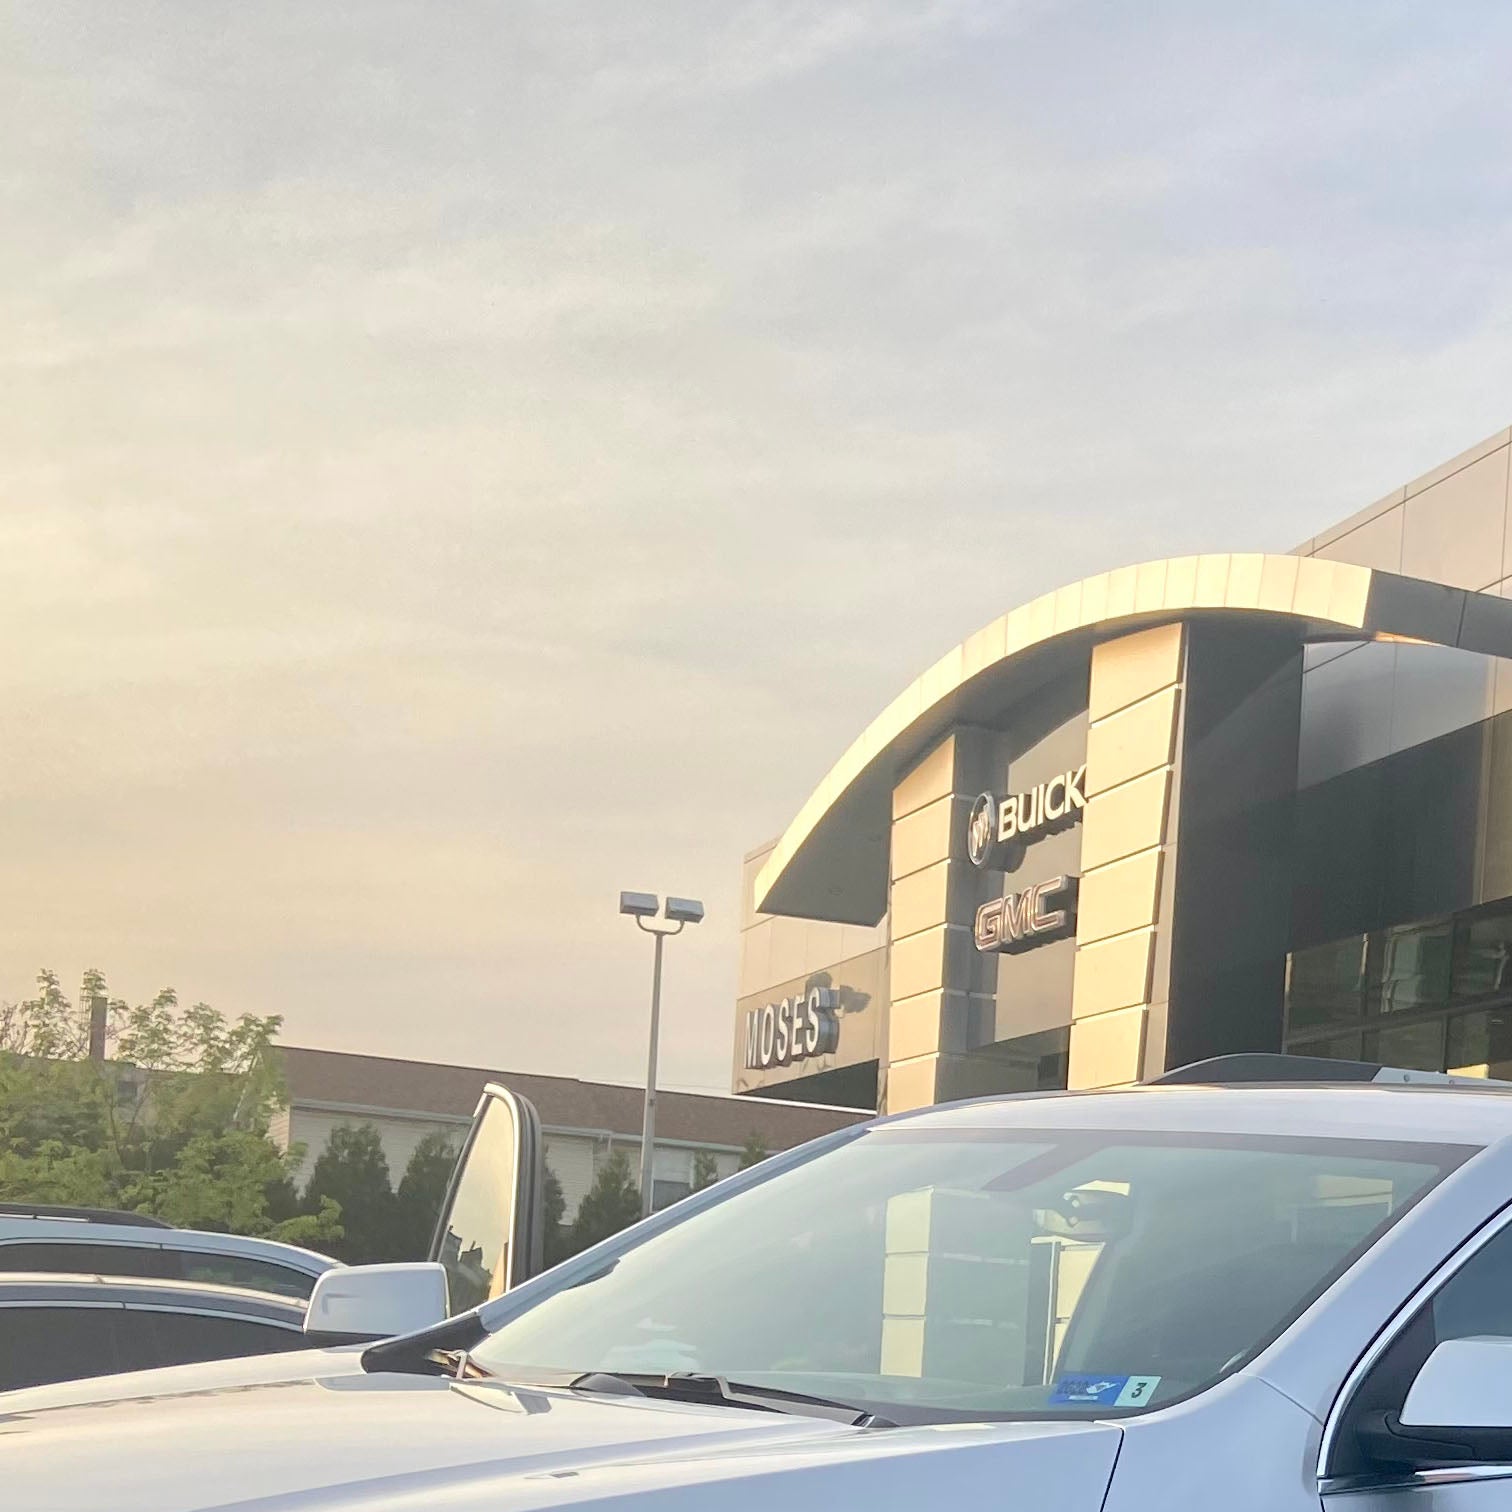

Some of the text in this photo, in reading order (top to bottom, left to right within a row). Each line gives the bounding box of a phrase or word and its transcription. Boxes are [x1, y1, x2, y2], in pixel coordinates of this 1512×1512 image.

[997, 764, 1088, 842] BUICK
[974, 875, 1070, 952] GMC
[744, 986, 831, 1070] MOSES
[1131, 1382, 1147, 1399] 3
